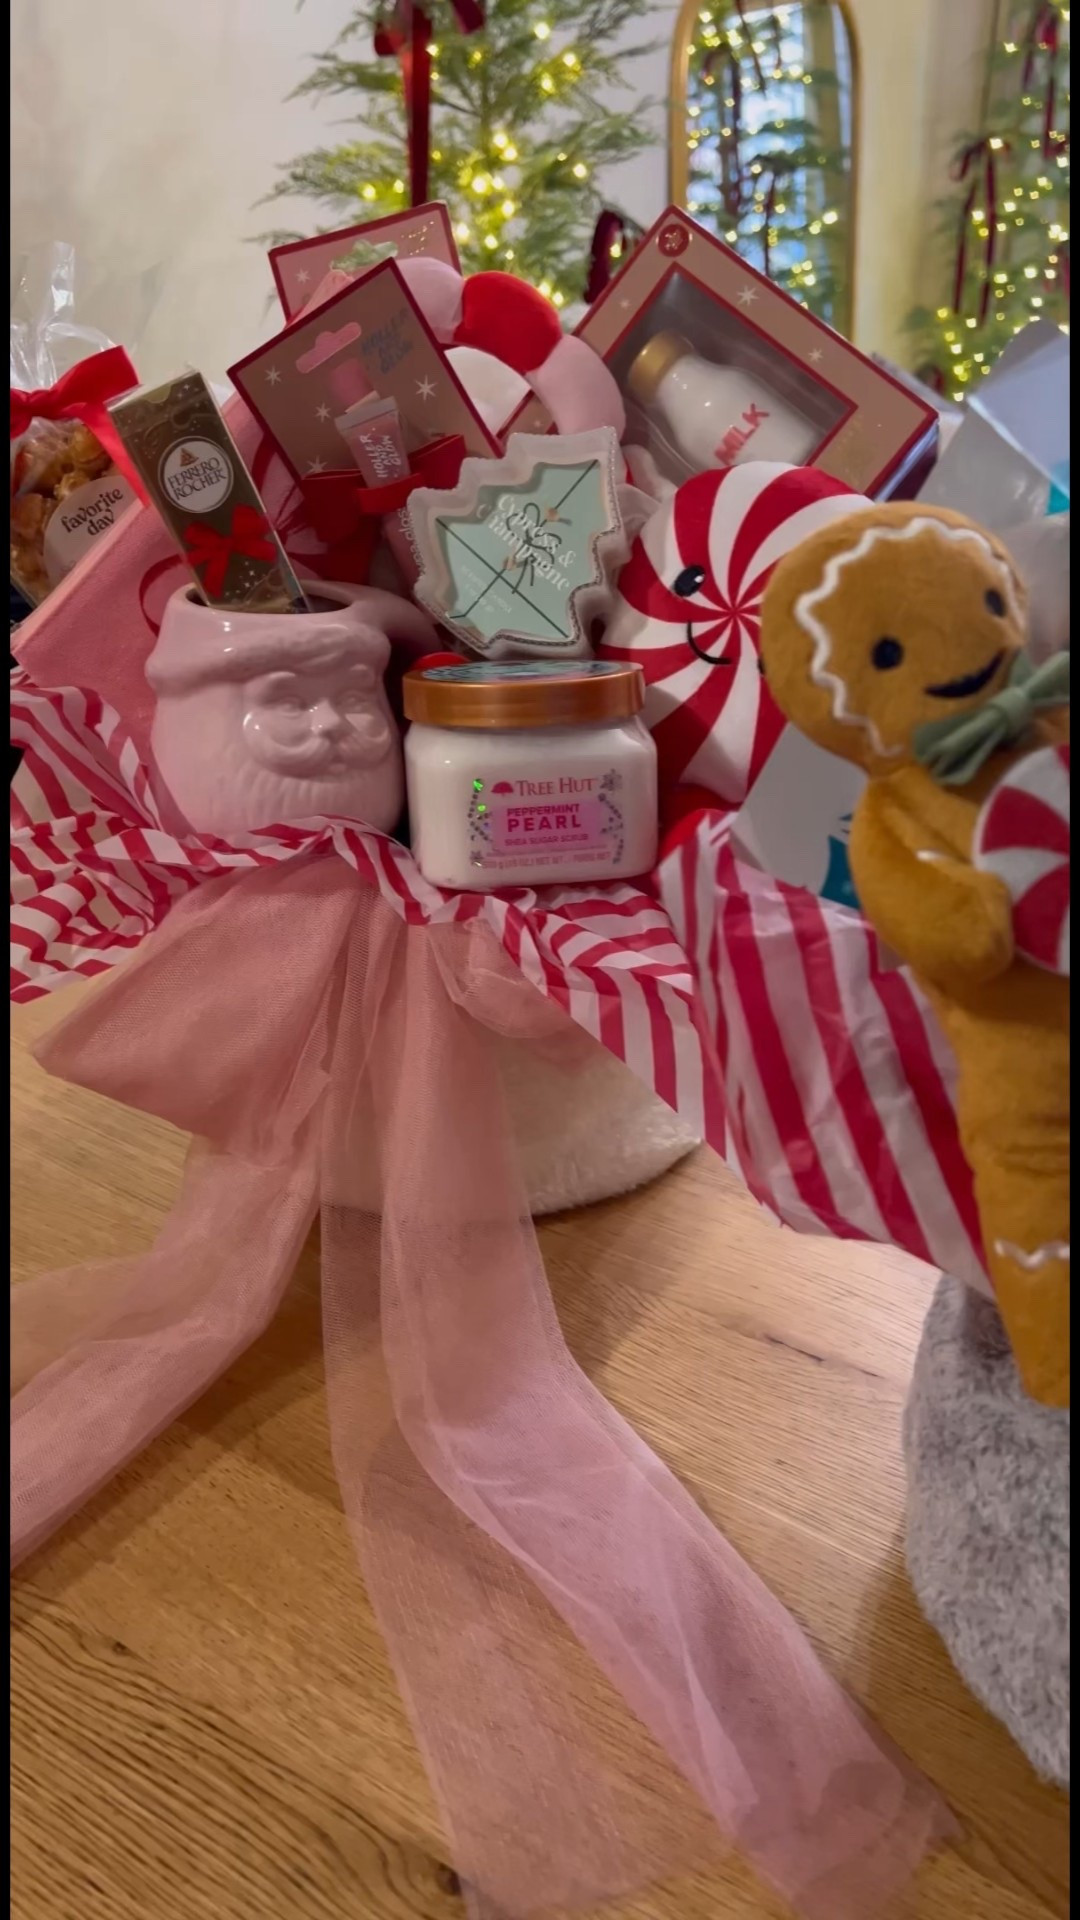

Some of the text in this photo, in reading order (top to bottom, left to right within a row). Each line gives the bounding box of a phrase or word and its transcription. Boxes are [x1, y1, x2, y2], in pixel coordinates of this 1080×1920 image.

[714, 402, 770, 467] MILK
[360, 433, 388, 478] HOLLER
[167, 457, 220, 489] FERRERO
[173, 467, 227, 500] ROCHER
[61, 488, 124, 533] favorite
[87, 508, 115, 536] day
[498, 494, 577, 568] Cypress &
[515, 776, 595, 797] TREE HUT
[507, 803, 580, 817] PEPPERMINT
[507, 814, 582, 833] PEARL
[504, 833, 589, 847] SHEA SUGAR SCRUB
